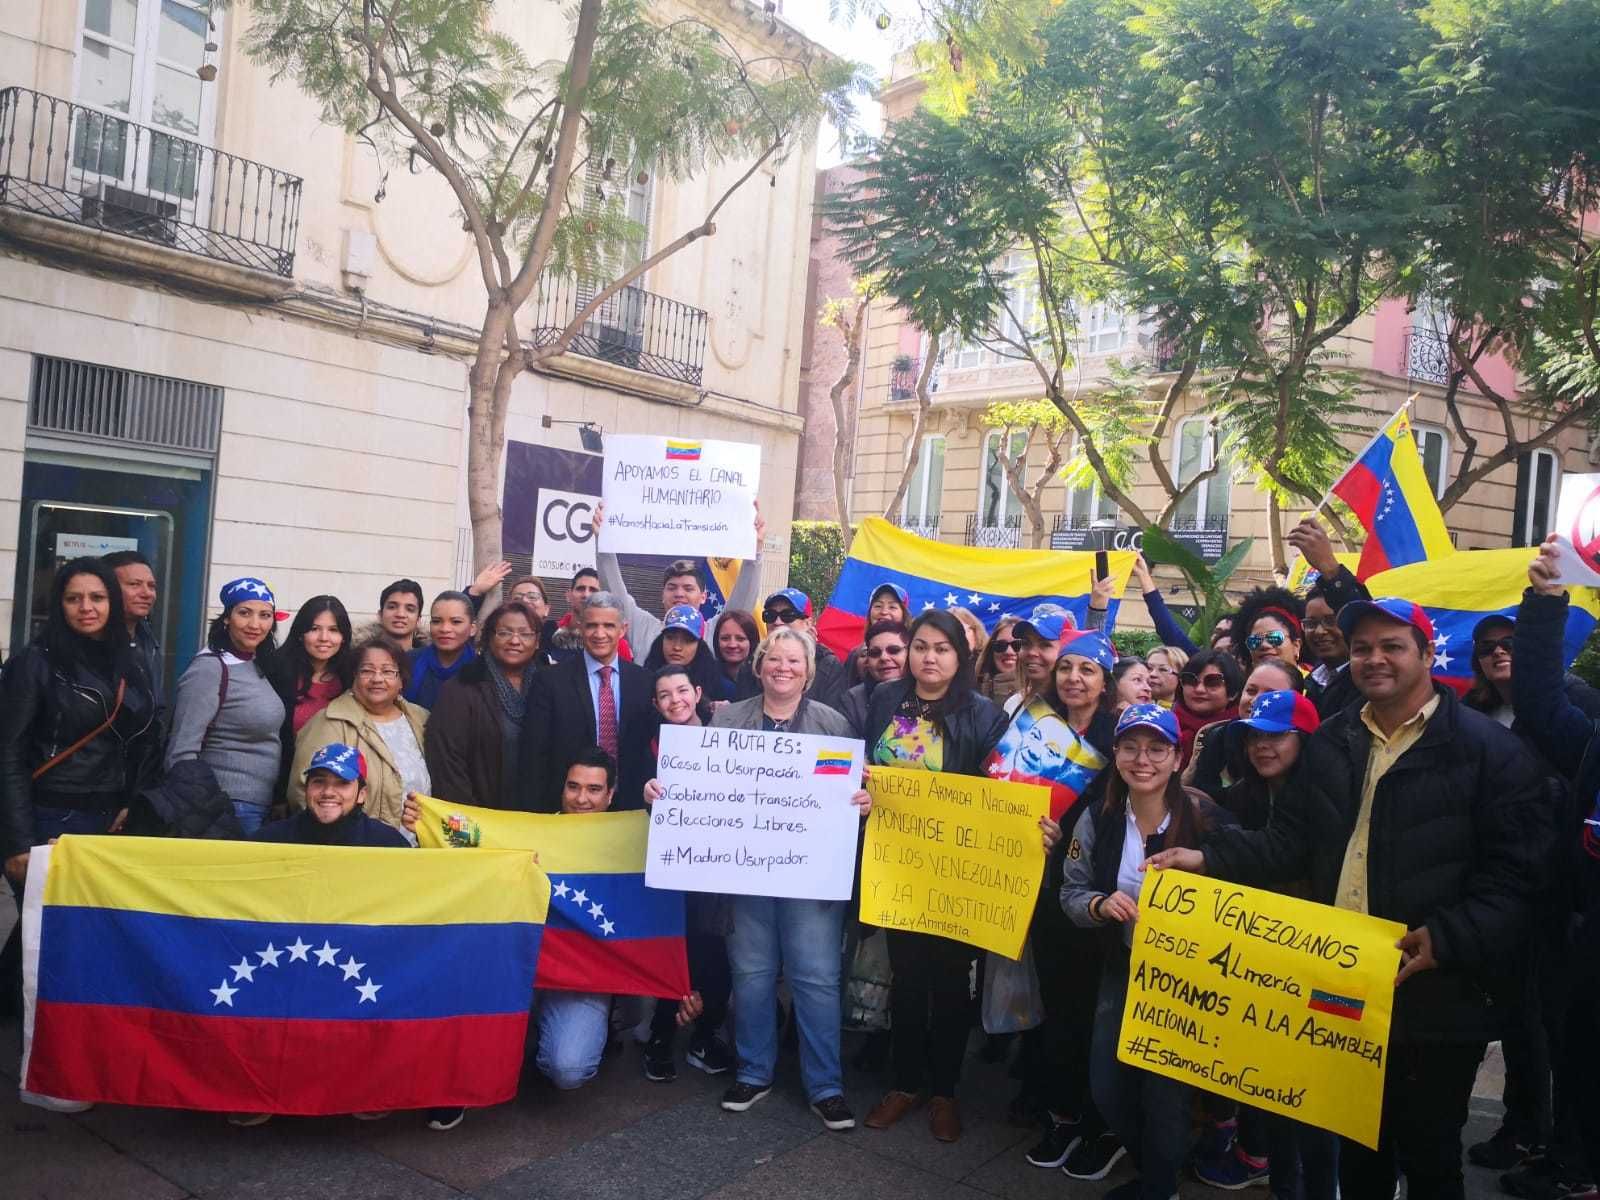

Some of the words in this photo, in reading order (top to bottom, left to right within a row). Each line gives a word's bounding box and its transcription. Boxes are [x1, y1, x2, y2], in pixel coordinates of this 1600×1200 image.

[614, 460, 680, 482] APOYAMOS
[689, 468, 703, 482] EL
[709, 467, 748, 487] CANAL
[543, 499, 594, 543] CG
[700, 729, 720, 749] LA
[728, 730, 766, 751] RUTA
[773, 736, 803, 755] ES:
[707, 755, 721, 774] la
[728, 787, 746, 803] de
[871, 771, 921, 798] FUERZA
[668, 807, 744, 829] Elecciones
[753, 813, 808, 833] Libres.
[874, 805, 945, 843] PONGANSE
[955, 825, 984, 850] DEL
[987, 831, 1024, 859] LADO
[873, 841, 892, 864] DE
[898, 846, 924, 870] LOS
[928, 851, 1031, 898] VENEZOLANOS
[870, 879, 882, 901] Y
[891, 883, 913, 905] LA
[1147, 873, 1198, 915] LOS
[1213, 888, 1360, 969] VENEZOLANOS
[1143, 926, 1200, 959] DESDE
[1134, 959, 1232, 1017] APOYAMOS
[1241, 1003, 1257, 1027] A
[1265, 1009, 1290, 1037] LA
[1295, 1016, 1384, 1069] ASAMBLEA
[1127, 1035, 1307, 1109] #EstamosConGuaidó
